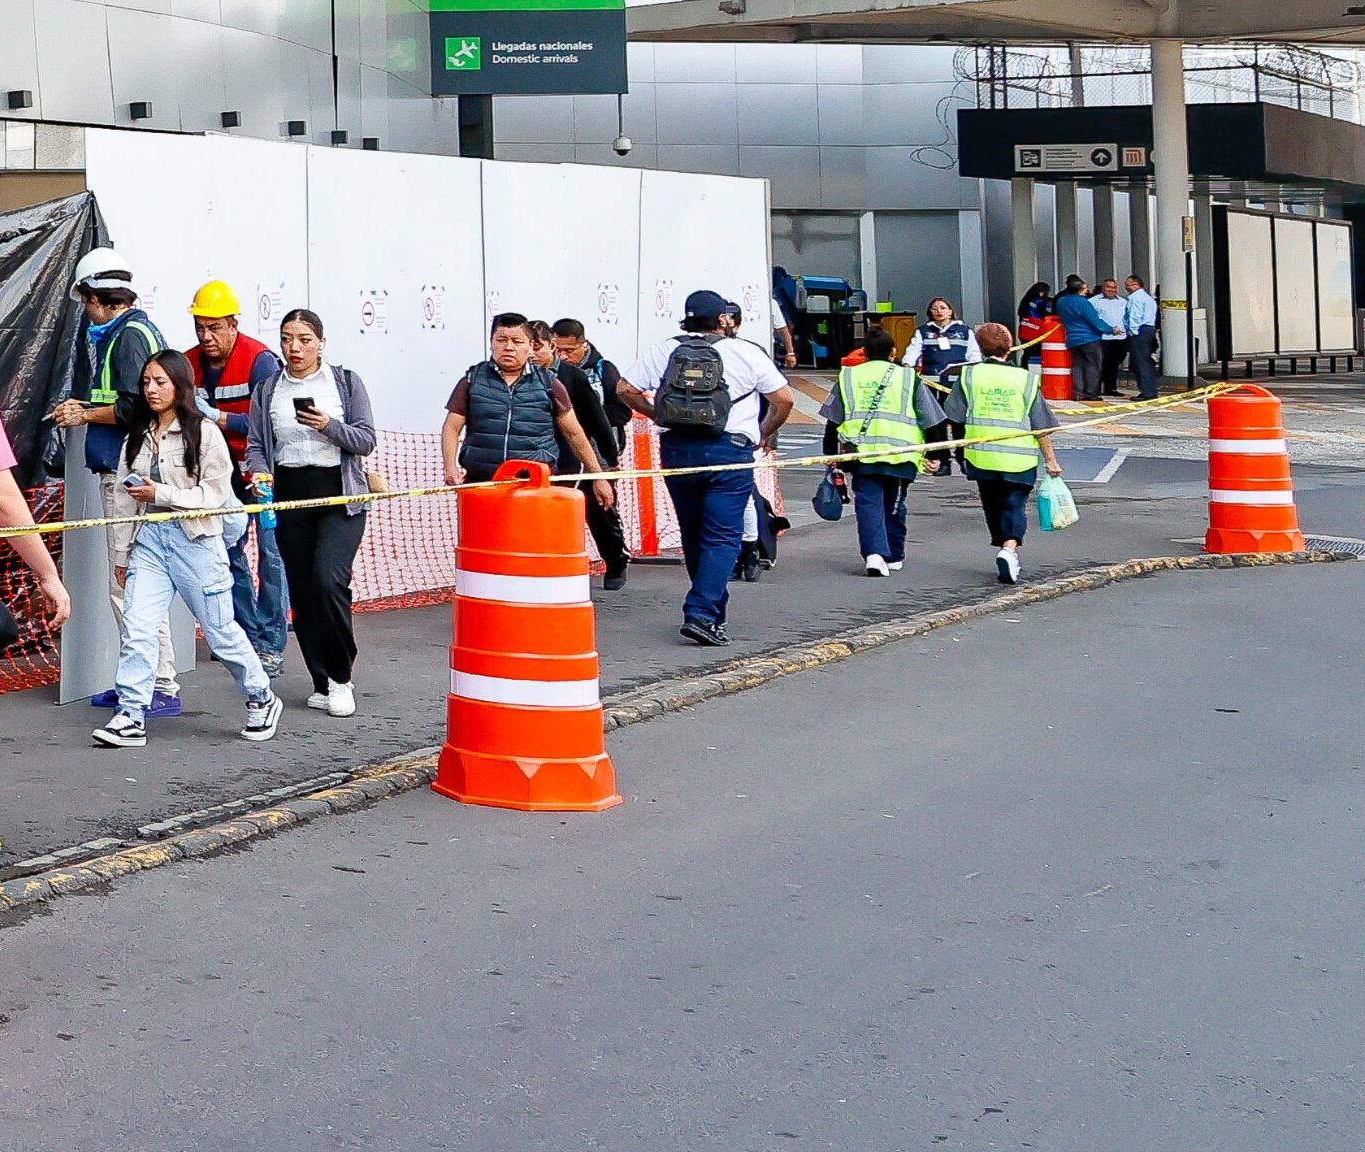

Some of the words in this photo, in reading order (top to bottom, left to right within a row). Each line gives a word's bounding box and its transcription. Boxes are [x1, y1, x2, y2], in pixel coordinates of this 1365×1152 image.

[491, 41, 537, 53] Llegadas
[539, 40, 594, 52] nacionales
[492, 53, 541, 64] Domestic
[542, 53, 579, 64] arrivals
